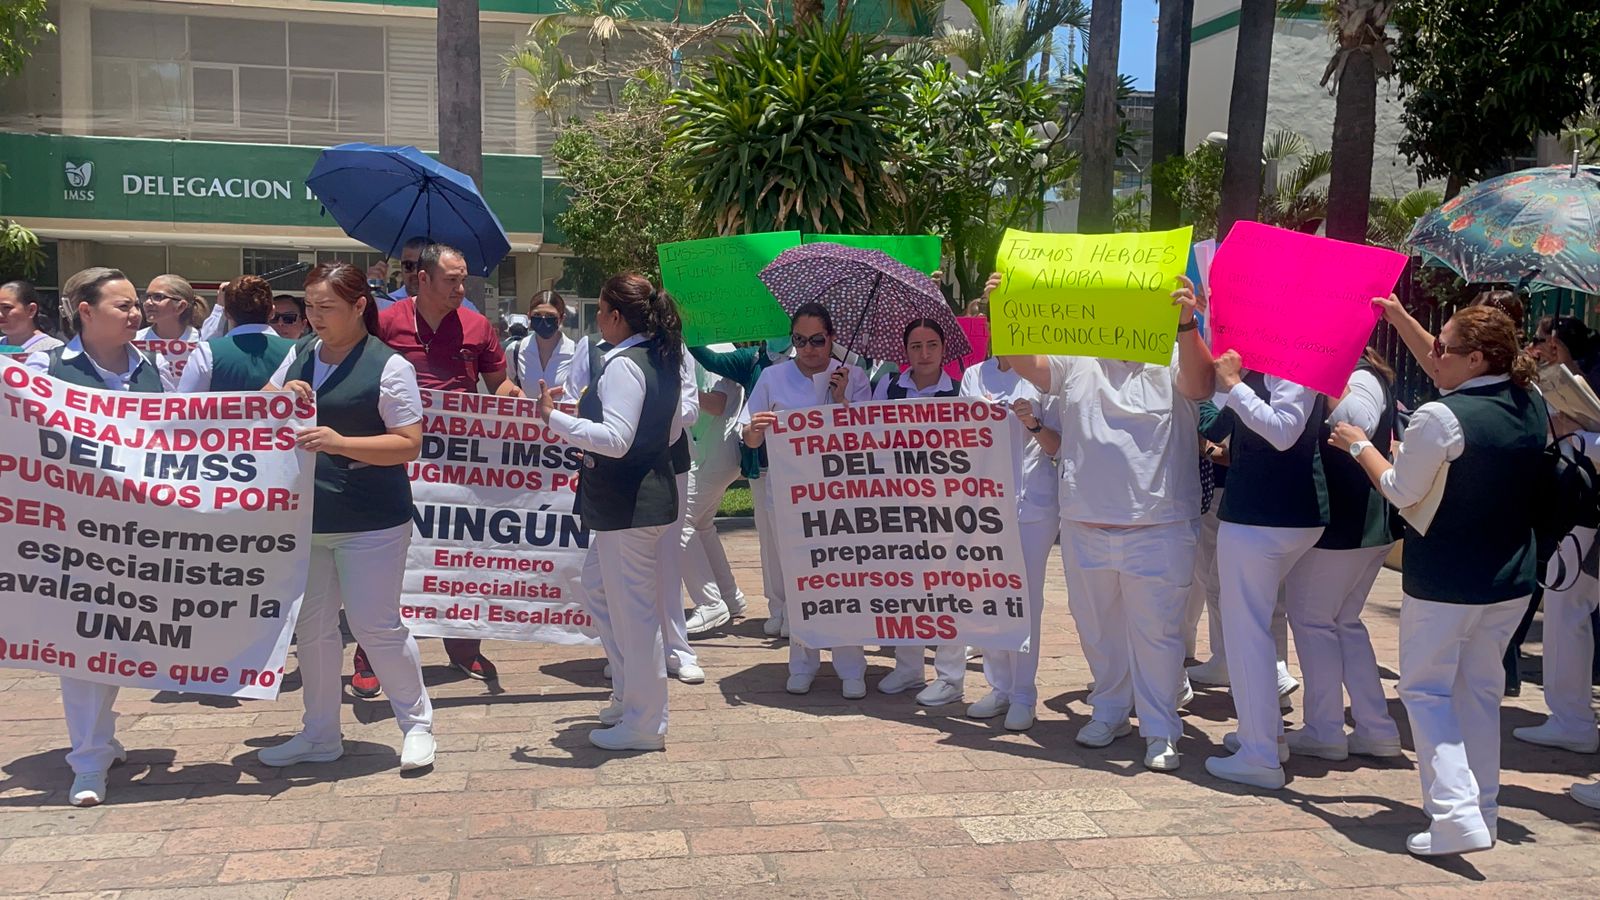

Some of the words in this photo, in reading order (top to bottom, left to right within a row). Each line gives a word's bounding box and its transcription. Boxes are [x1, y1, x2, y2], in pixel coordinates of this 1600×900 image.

[64, 190, 95, 201] IMSS
[122, 174, 294, 200] DELEGACION
[1007, 238, 1073, 262] FUIMOS
[1089, 242, 1177, 264] HEROES
[1003, 266, 1015, 294] Y
[1032, 269, 1104, 290] AHORA
[1126, 270, 1164, 292] NO
[1003, 299, 1095, 320] QUIEREN
[1007, 322, 1170, 355] RECONOCERNOS
[0, 365, 53, 399] OS
[65, 387, 316, 421] ENFERMEROS
[4, 393, 295, 452] TRABAJADORES
[772, 412, 824, 435] LOS
[832, 401, 1007, 428] ENFERMEROS
[38, 428, 125, 473] DEL
[143, 452, 257, 482] IMSS
[421, 435, 488, 463] DEL
[501, 442, 582, 470] IMSS
[789, 427, 994, 457] TRABAJADORES
[404, 462, 542, 490] UGMANOS
[821, 452, 884, 478] DEL
[894, 450, 971, 475] IMSS
[213, 486, 299, 512] POR:
[791, 478, 937, 505] PUGMANOS
[944, 477, 1005, 498] POR:
[77, 518, 296, 553] enfermeros
[410, 504, 590, 549] NINGÚN
[801, 505, 1004, 538] HABERNOS
[17, 539, 265, 587] especialistas
[434, 549, 554, 572] Enfermero
[810, 540, 947, 569] preparado
[956, 542, 1004, 561] con
[422, 575, 561, 599] Especialista
[797, 570, 913, 591] recursos
[923, 568, 1022, 592] propios
[0, 571, 158, 614] avalados
[172, 597, 237, 622] por
[249, 594, 281, 618] la
[801, 599, 861, 621] para
[870, 593, 973, 614] servirte
[982, 601, 998, 616] a
[1005, 597, 1024, 618] ti
[445, 603, 480, 621] del
[76, 611, 192, 649] UNAM
[875, 615, 958, 640] IMSS
[87, 651, 158, 679] dice
[169, 664, 229, 686] que
[239, 667, 284, 688] no
